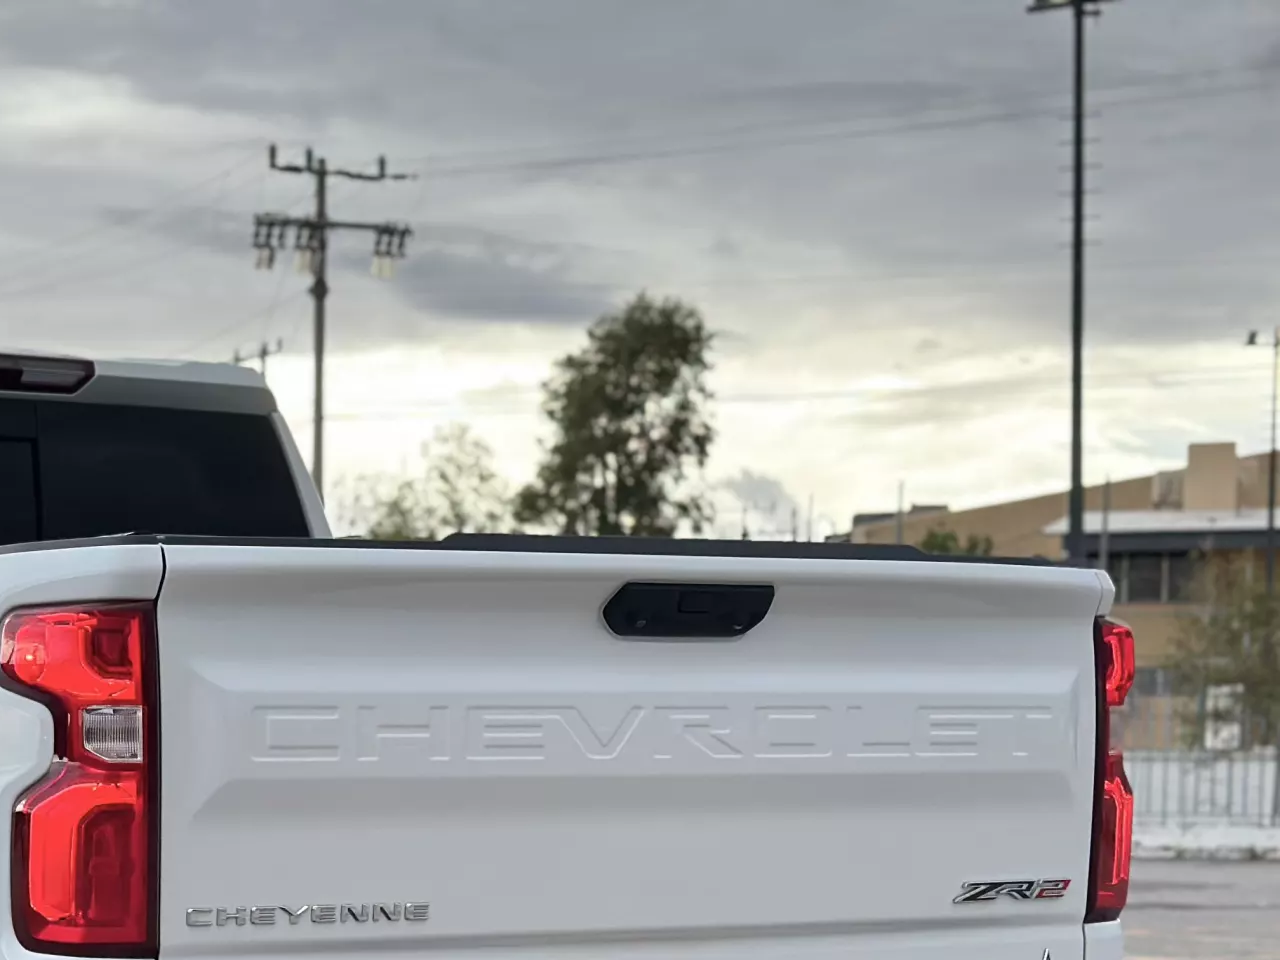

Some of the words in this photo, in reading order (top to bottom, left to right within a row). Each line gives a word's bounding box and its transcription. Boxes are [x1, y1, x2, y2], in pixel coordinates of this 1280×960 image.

[251, 705, 1052, 761] CHEVROLET
[953, 878, 1071, 903] ZR2
[186, 902, 430, 927] CHEYENNE
